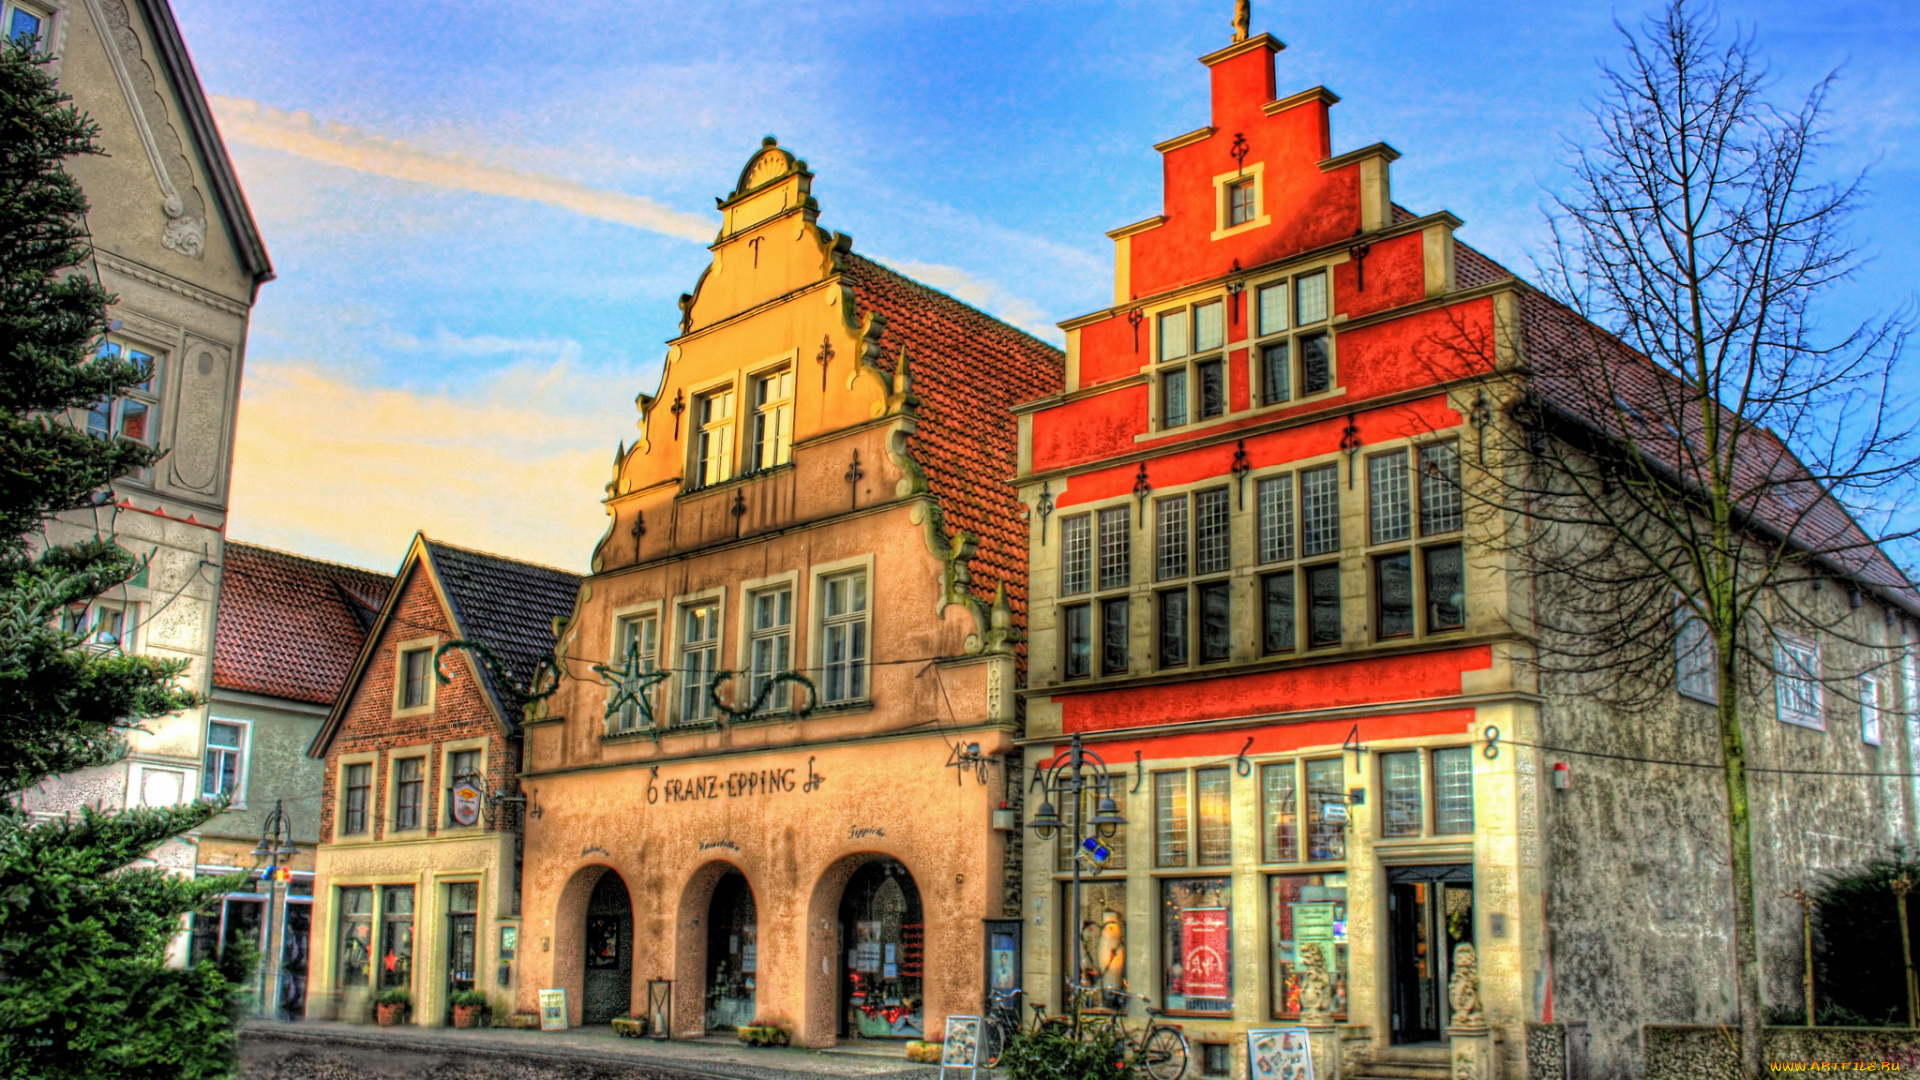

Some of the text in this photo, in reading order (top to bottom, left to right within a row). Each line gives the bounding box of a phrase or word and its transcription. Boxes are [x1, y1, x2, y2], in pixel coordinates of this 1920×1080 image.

[1236, 736, 1255, 777] 6
[1342, 723, 1369, 774] 4
[1484, 725, 1500, 760] 8
